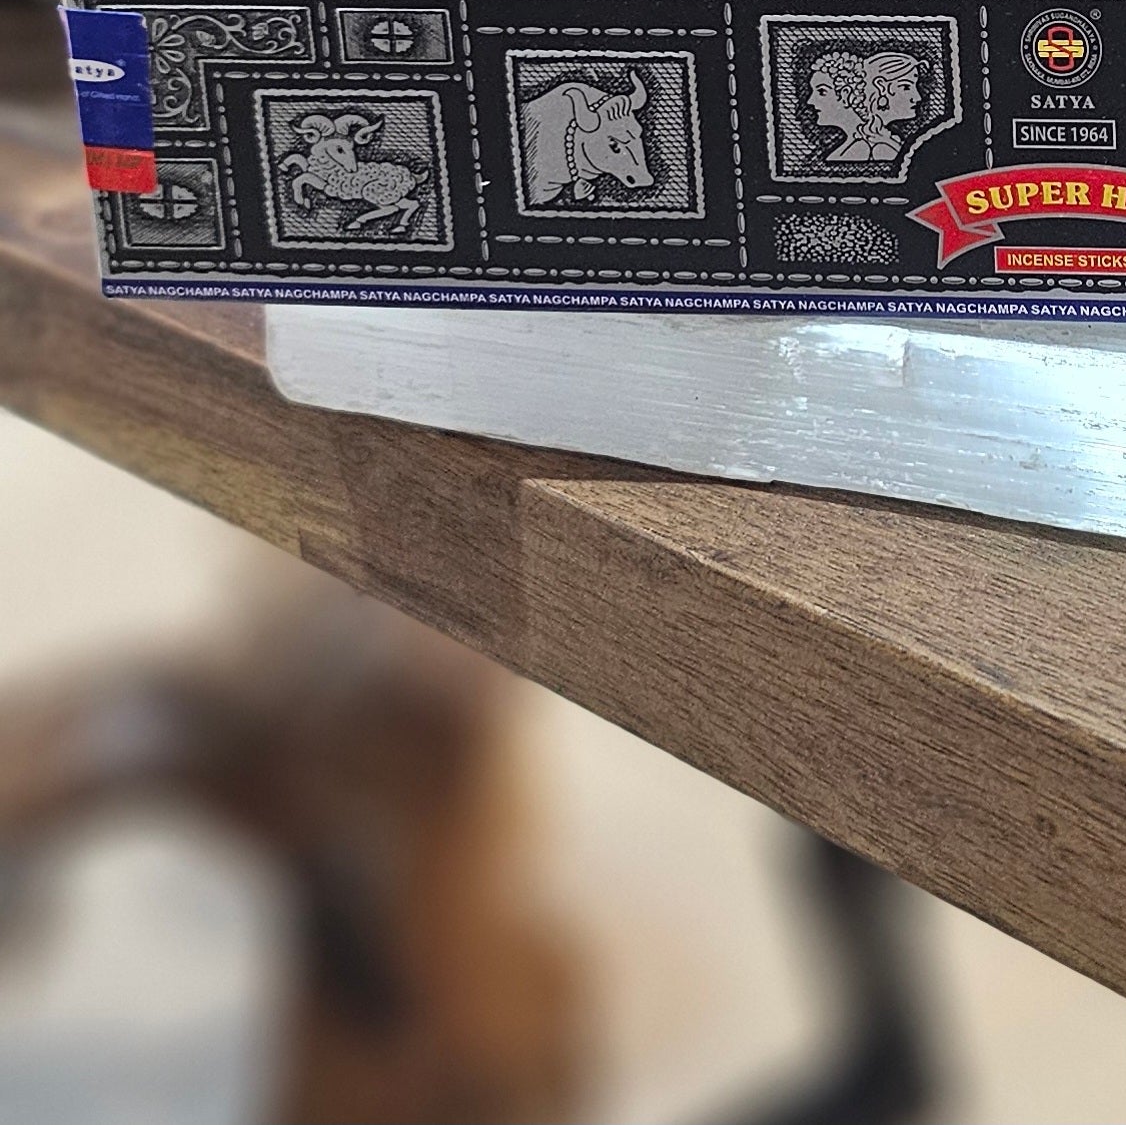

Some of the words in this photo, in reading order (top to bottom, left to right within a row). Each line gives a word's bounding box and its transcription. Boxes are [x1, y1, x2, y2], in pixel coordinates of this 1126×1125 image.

[1030, 94, 1096, 110] SATYA
[1020, 125, 1066, 142] SINCE
[1070, 126, 1109, 143] 1964
[966, 181, 1091, 214] SUPER
[1007, 253, 1073, 267] INCENSE
[107, 285, 146, 295] SATYA
[149, 286, 229, 297] NAGCHAMPA
[232, 287, 272, 298] SATYA
[275, 289, 357, 300] NAGCHAMPA
[360, 290, 400, 301] SATYA
[404, 292, 486, 303] NAGCHAMPA
[489, 293, 530, 304] SATYA
[533, 294, 617, 306] NAGCHAMPA
[621, 296, 662, 307] SATYA
[665, 297, 750, 309] NAGCHAMPA
[754, 299, 795, 310] SATYA
[799, 300, 884, 312] NAGCHAMPA
[888, 301, 933, 313] SATYA
[936, 302, 1028, 315] NAGCHAMPA
[1031, 304, 1077, 316] SATYA
